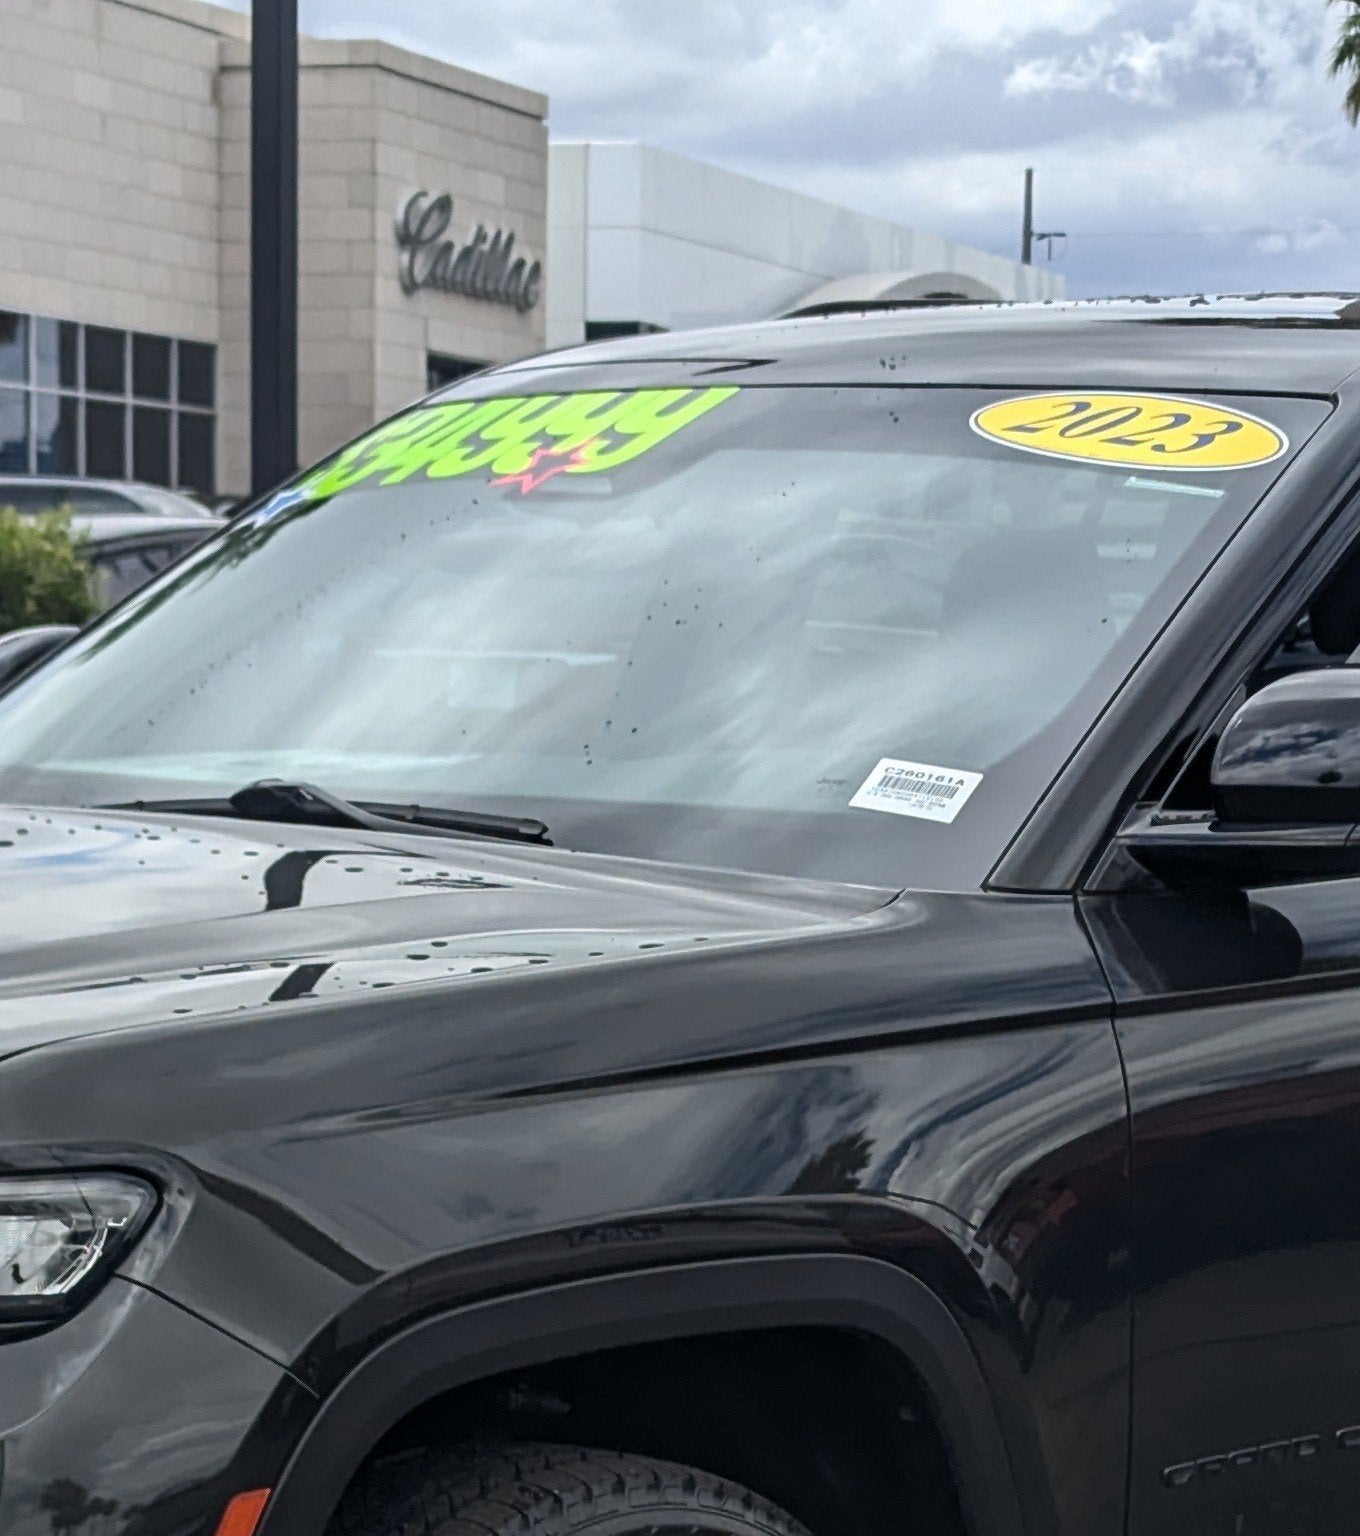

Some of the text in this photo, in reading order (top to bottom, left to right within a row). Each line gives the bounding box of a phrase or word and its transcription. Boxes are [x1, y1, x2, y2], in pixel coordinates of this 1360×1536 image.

[395, 190, 542, 313] Cadillac
[1001, 401, 1243, 453] 2023
[1160, 1433, 1321, 1487] GRAND
